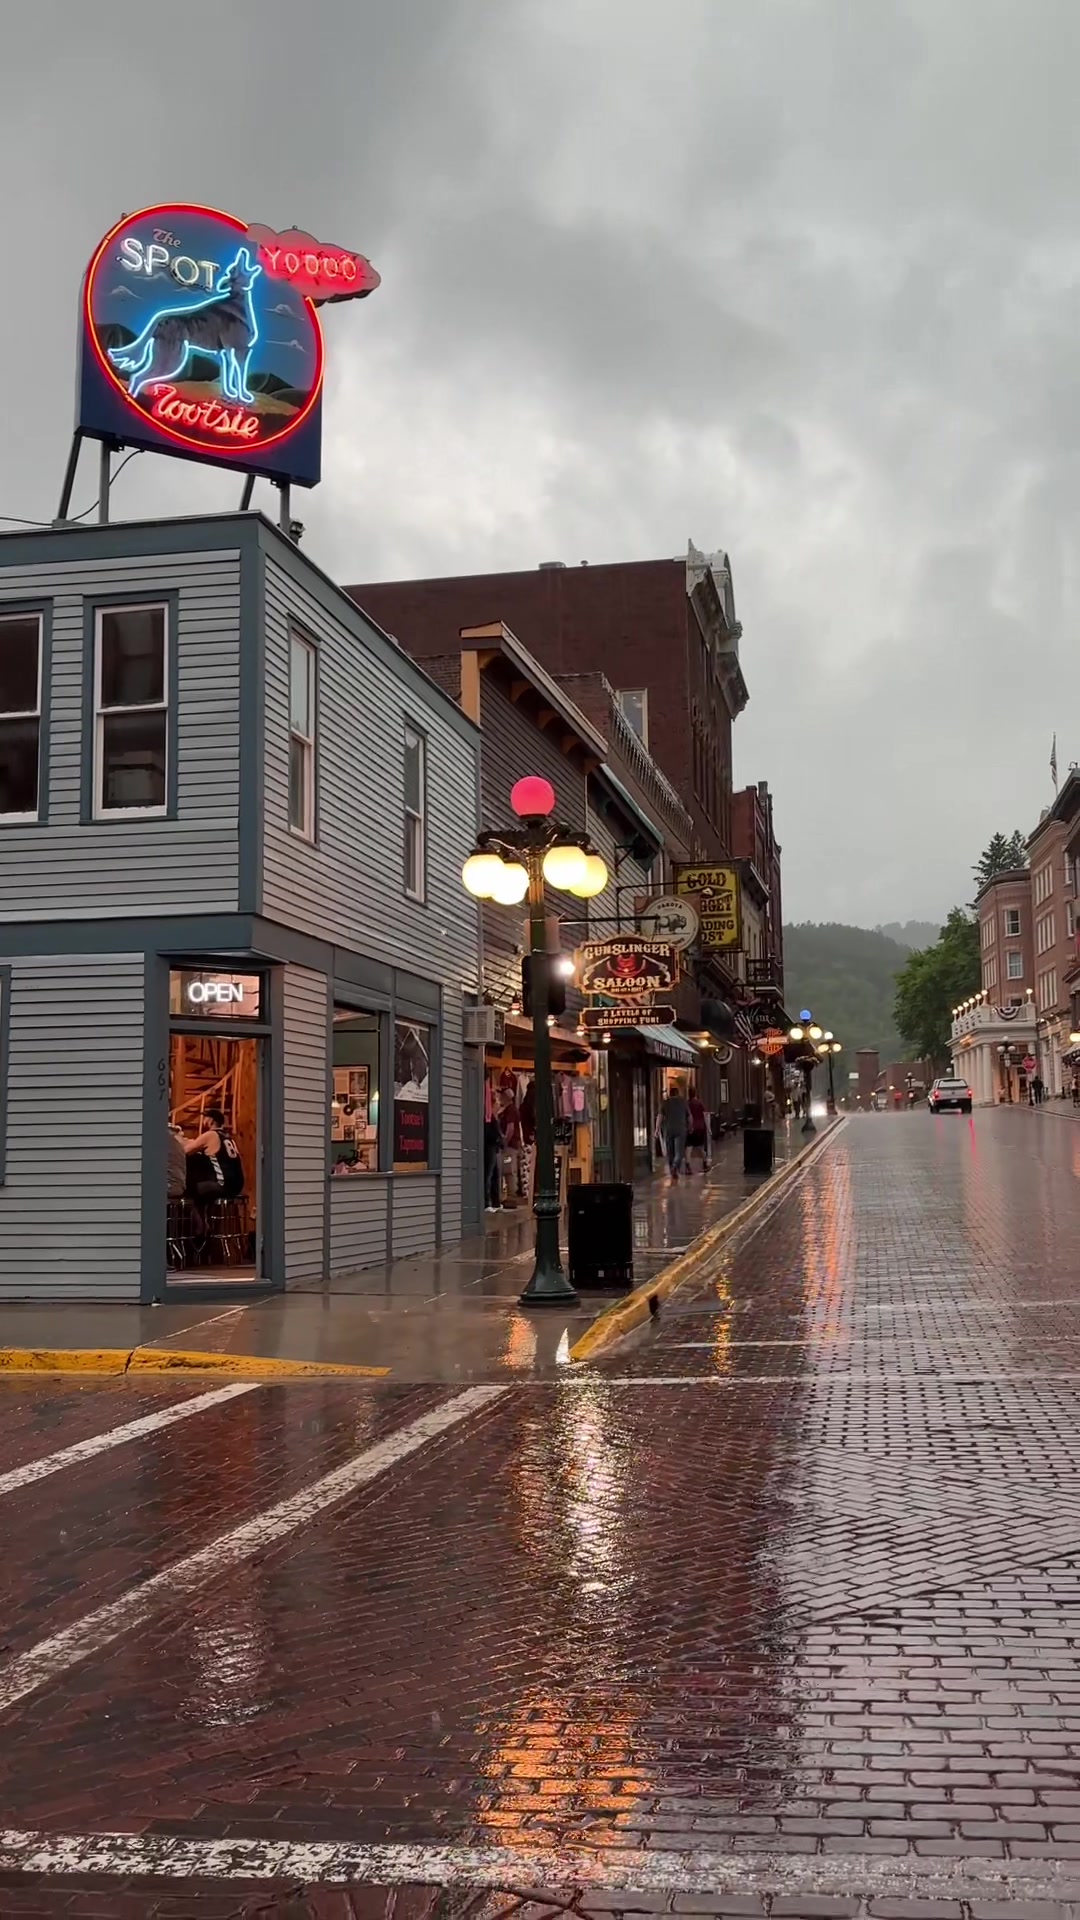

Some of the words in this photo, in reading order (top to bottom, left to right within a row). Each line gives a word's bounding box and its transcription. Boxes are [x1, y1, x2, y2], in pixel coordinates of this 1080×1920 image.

[152, 228, 182, 248] The
[117, 238, 221, 292] SPOT
[153, 383, 260, 440] Tootsie
[686, 872, 727, 889] GOLD
[656, 902, 683, 910] DAKOTA
[701, 894, 733, 912] GGET
[701, 931, 725, 942] OST
[584, 943, 670, 960] GUNSLINGER
[593, 975, 660, 990] SALOON
[188, 982, 243, 1002] OPEN
[597, 1017, 638, 1026] SHOPPING
[610, 1009, 640, 1018] LEVELS
[641, 1008, 652, 1016] OF
